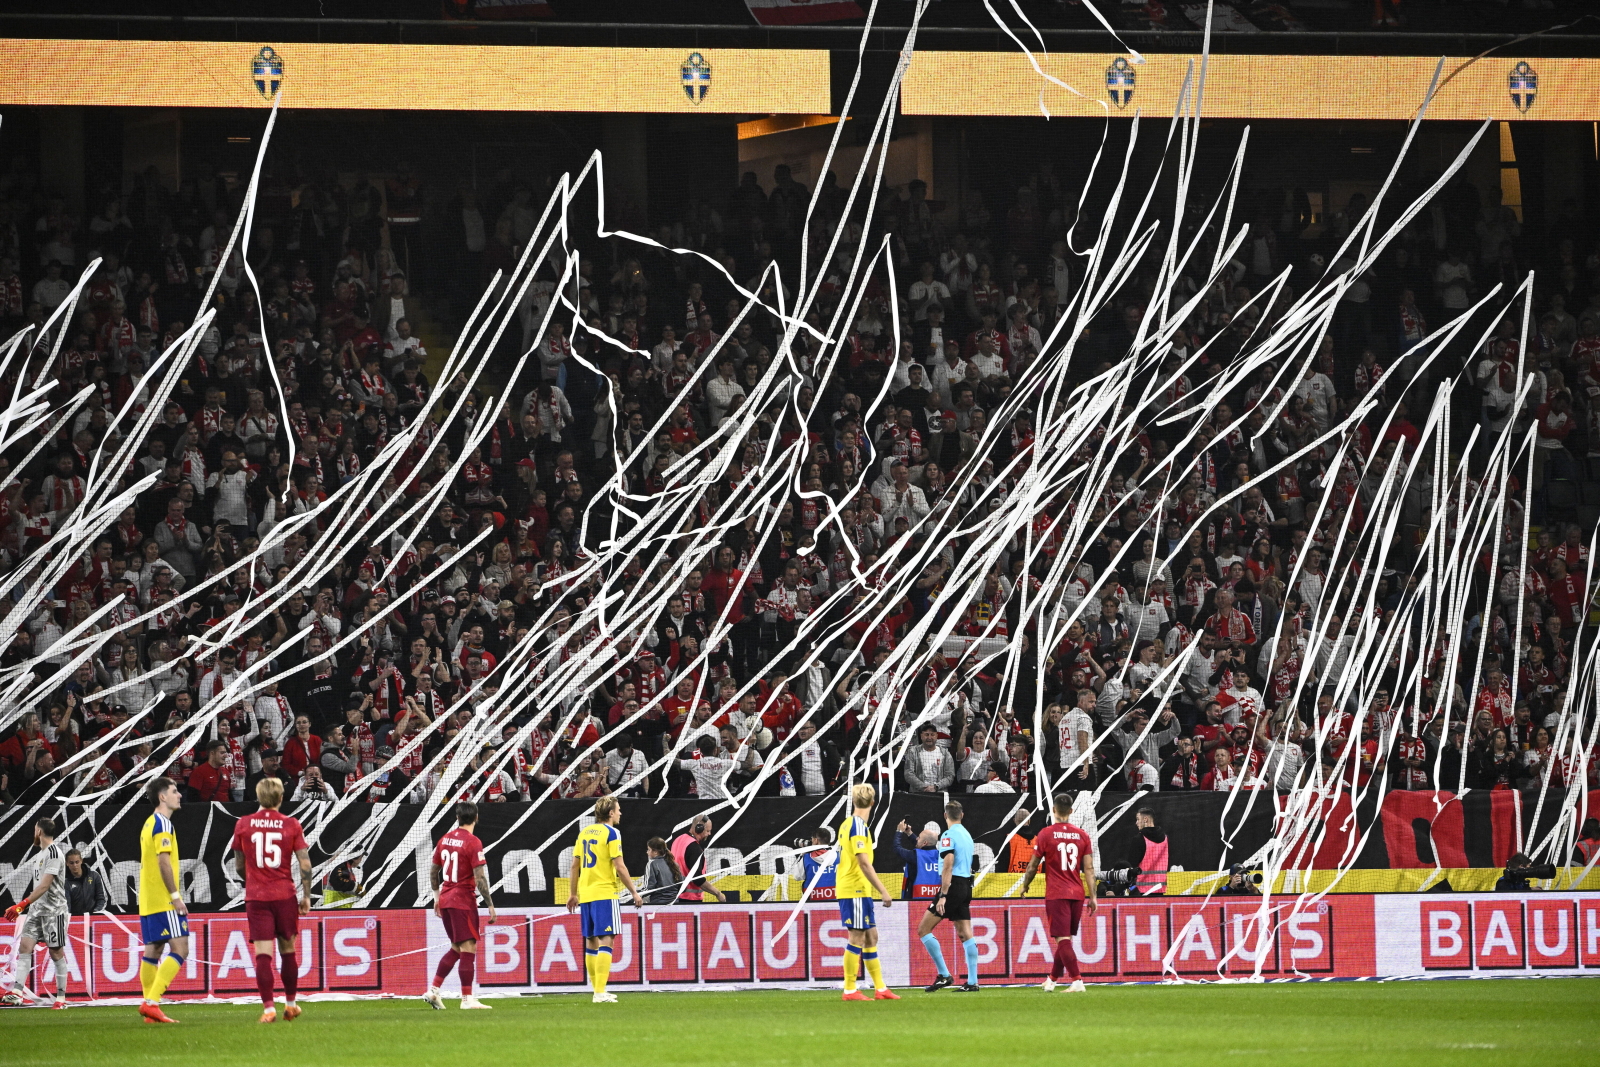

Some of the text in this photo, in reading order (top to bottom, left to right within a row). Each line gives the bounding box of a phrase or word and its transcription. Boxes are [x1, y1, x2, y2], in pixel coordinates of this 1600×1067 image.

[1137, 35, 1205, 47] LEWNDOWSKI
[250, 818, 283, 829] PUCHACZ
[251, 831, 283, 869] 15
[582, 839, 598, 869] 15
[1057, 842, 1079, 872] 13
[440, 849, 459, 884] 21
